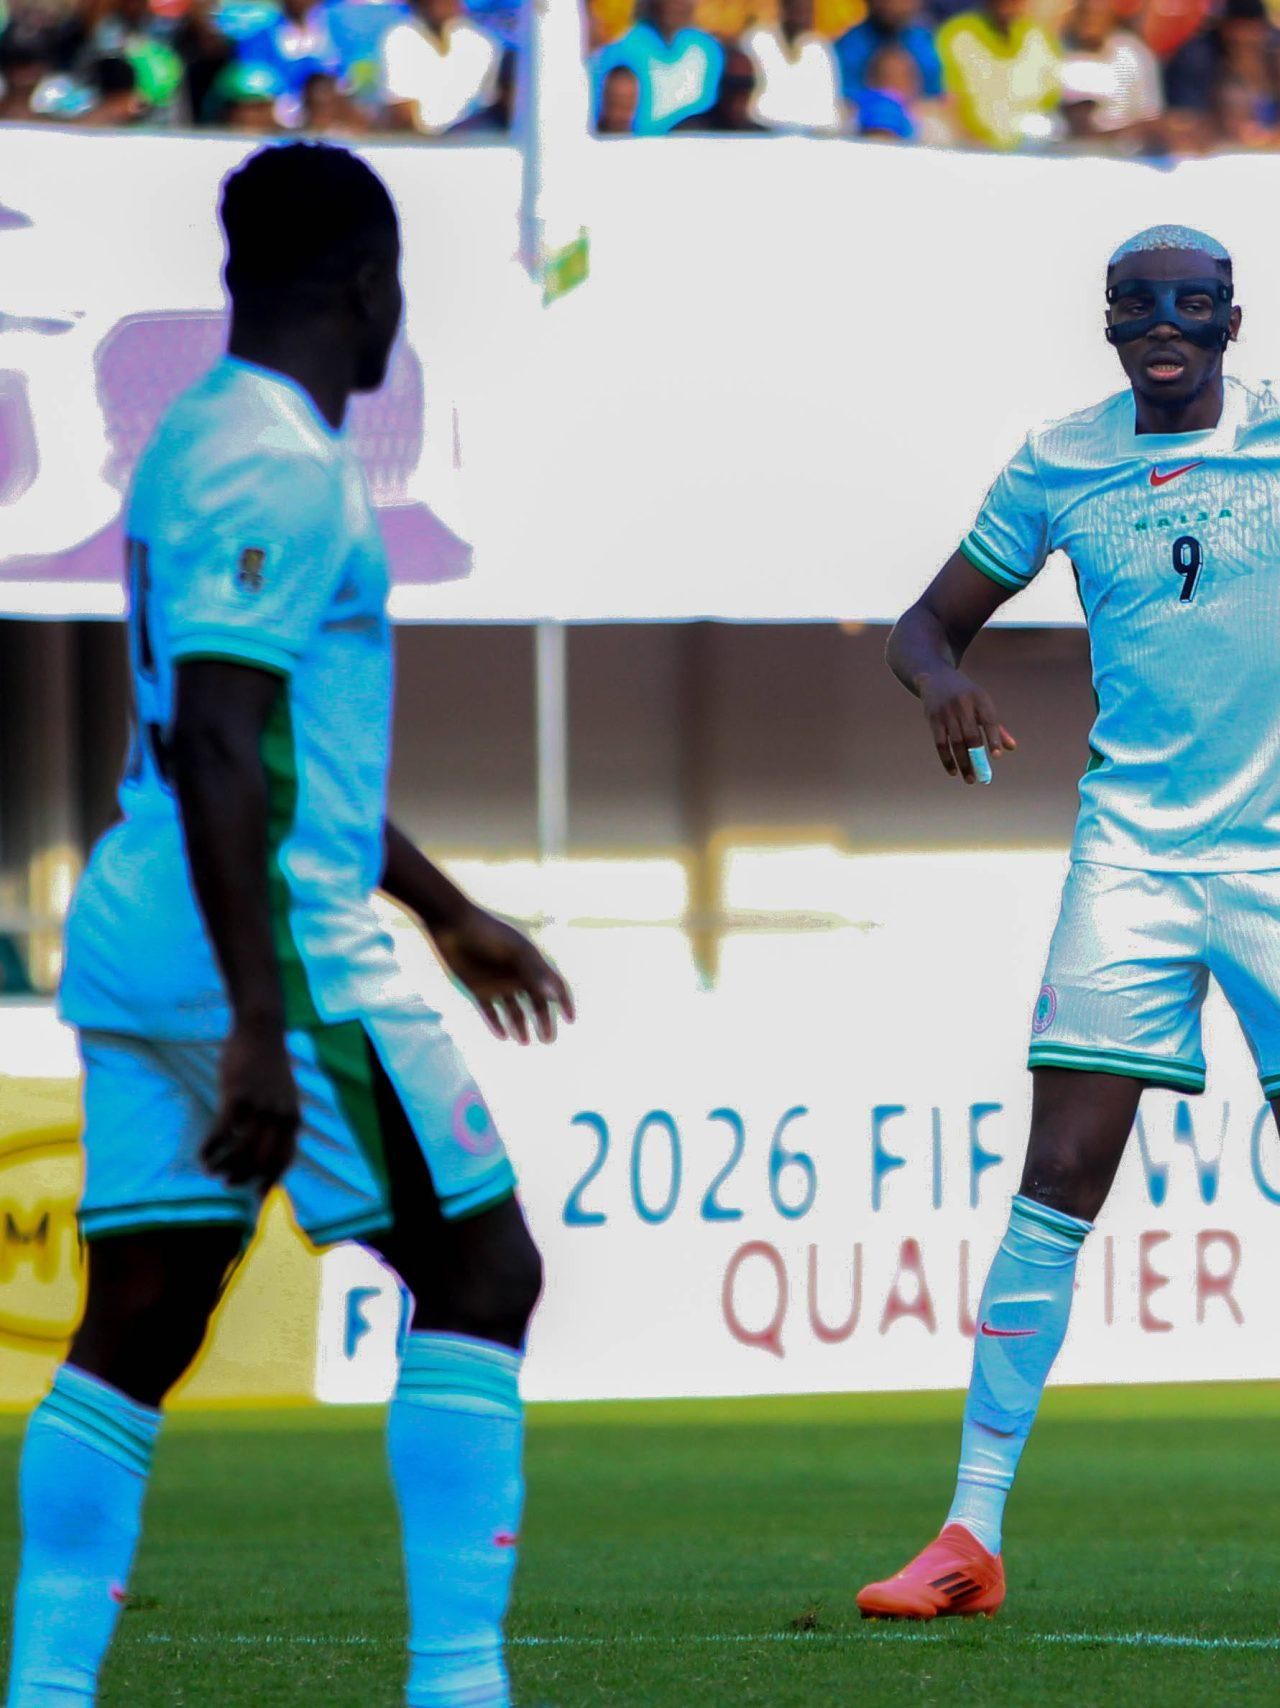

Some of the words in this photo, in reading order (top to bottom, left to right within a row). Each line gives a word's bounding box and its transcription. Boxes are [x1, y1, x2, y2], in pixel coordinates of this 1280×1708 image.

[1172, 535, 1204, 603] 9
[562, 1105, 819, 1228] 2026
[871, 1101, 1005, 1212] FIF
[721, 1228, 1246, 1359] QUALIER
